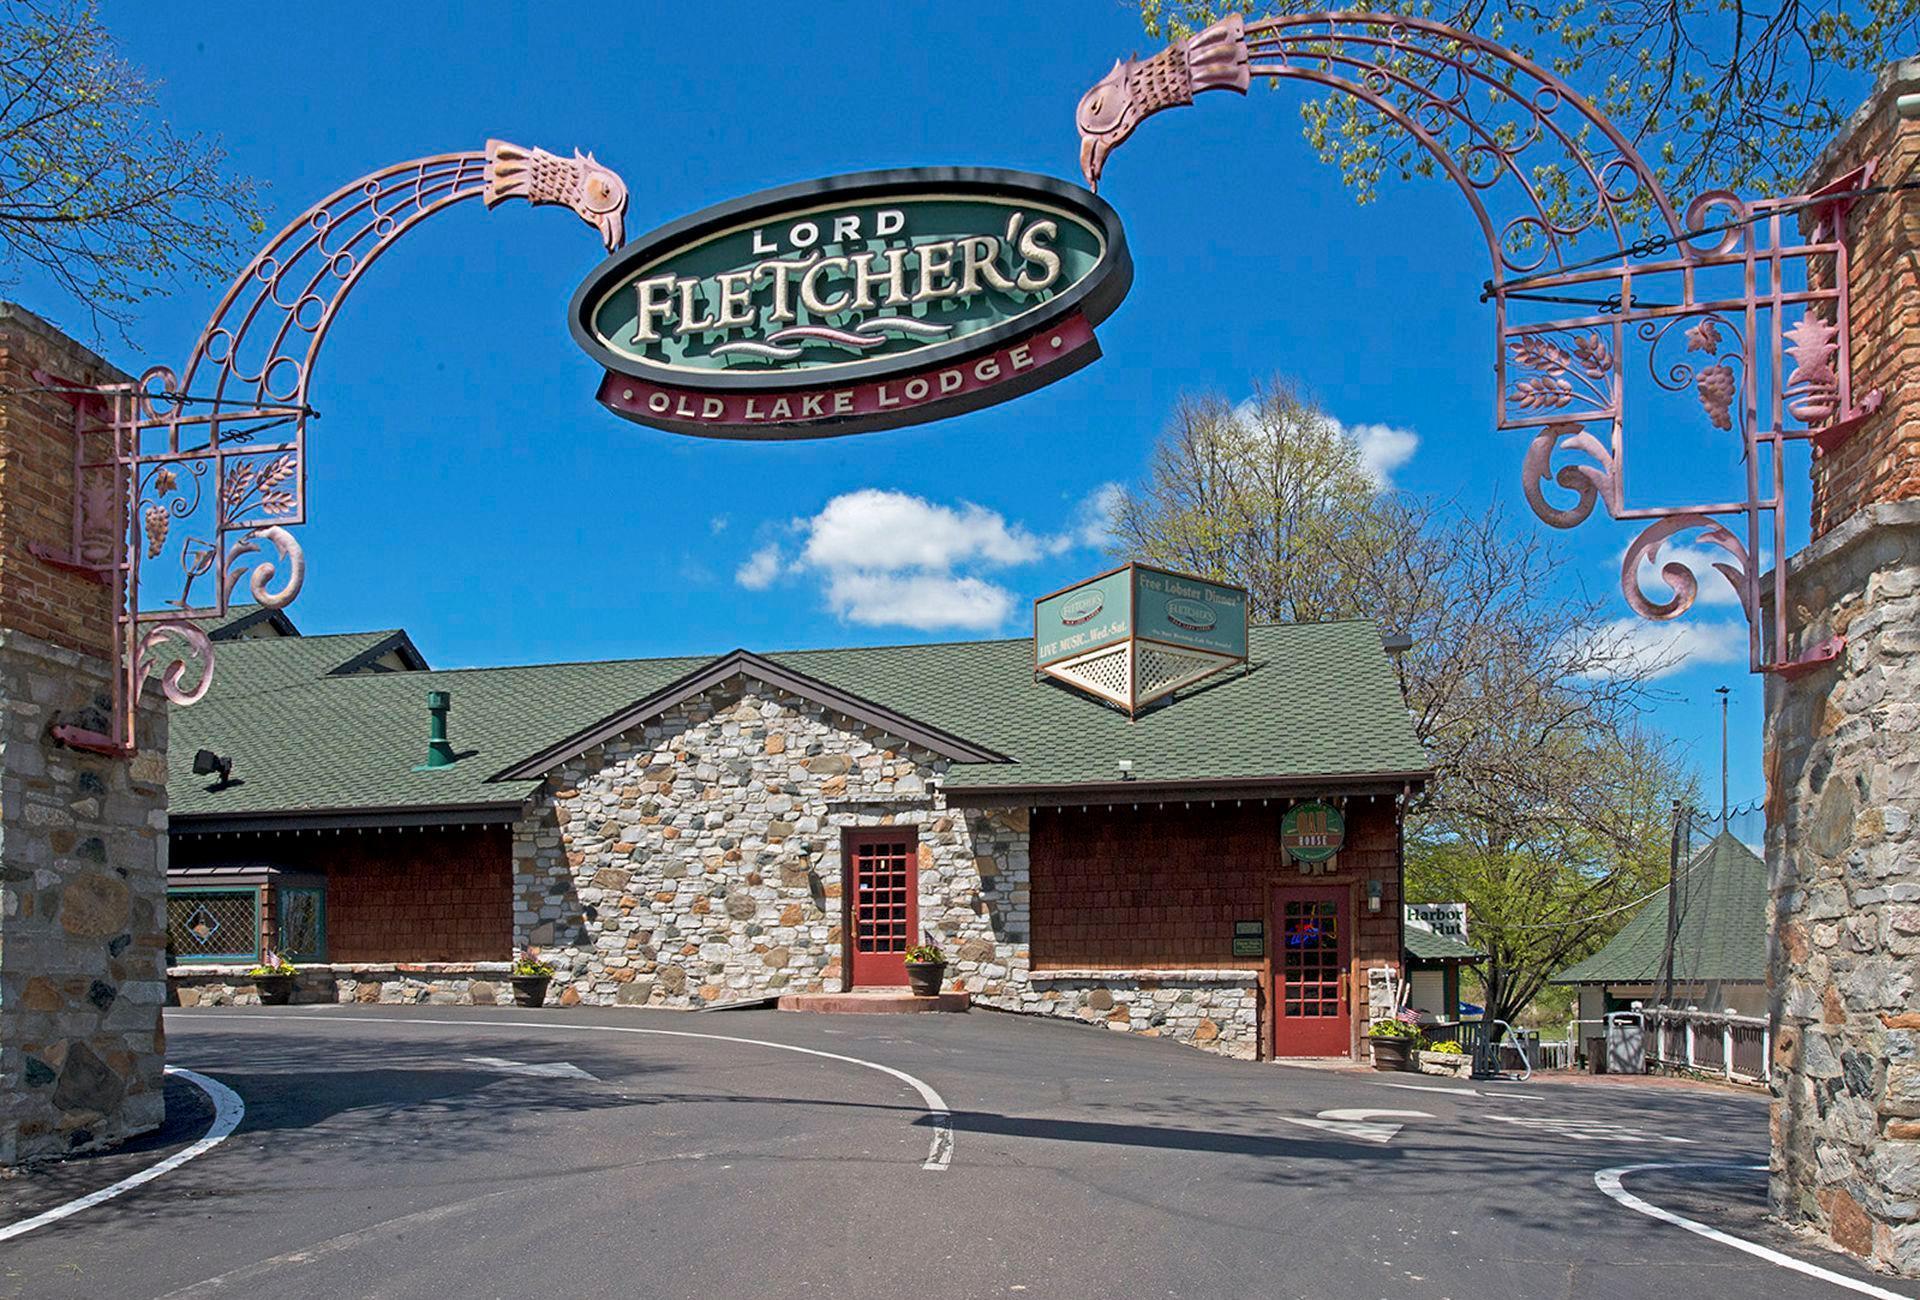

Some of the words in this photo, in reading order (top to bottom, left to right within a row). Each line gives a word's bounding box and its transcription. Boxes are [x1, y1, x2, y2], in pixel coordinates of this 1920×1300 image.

[752, 209, 906, 255] LORD
[629, 210, 1063, 346] FLETCHER'S
[648, 391, 724, 419] OLD
[744, 389, 855, 420] LAKE
[877, 347, 1034, 407] LODGE
[1139, 574, 1162, 591] Free
[1164, 579, 1201, 600] Lobster
[1040, 641, 1058, 658] LIVE
[1407, 908, 1463, 921] Harbor
[1431, 922, 1462, 935] Hut
